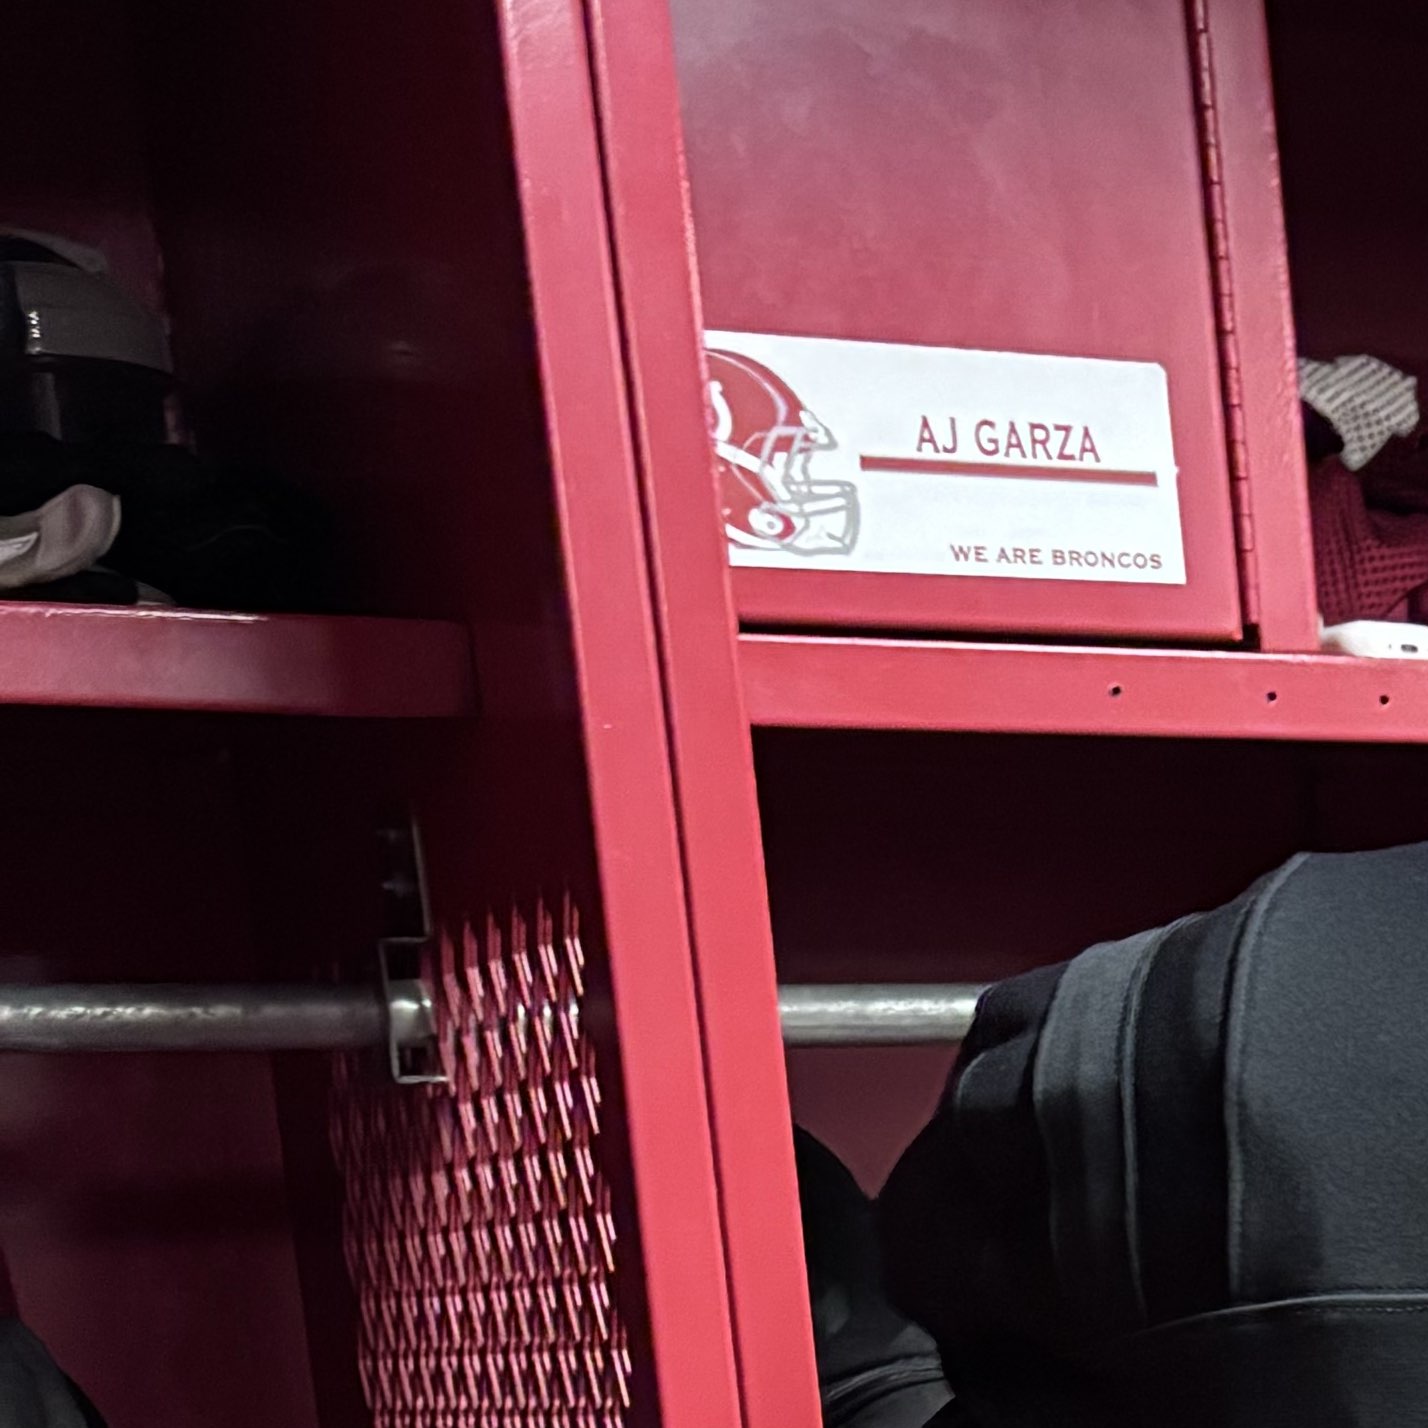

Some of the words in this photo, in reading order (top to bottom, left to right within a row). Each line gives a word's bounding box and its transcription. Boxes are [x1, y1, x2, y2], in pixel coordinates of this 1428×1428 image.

[917, 415, 958, 453] AJ
[974, 419, 1101, 463] GARZA
[950, 544, 988, 563] WE
[997, 548, 1043, 565] ARE
[1052, 550, 1163, 569] BRONCOS
